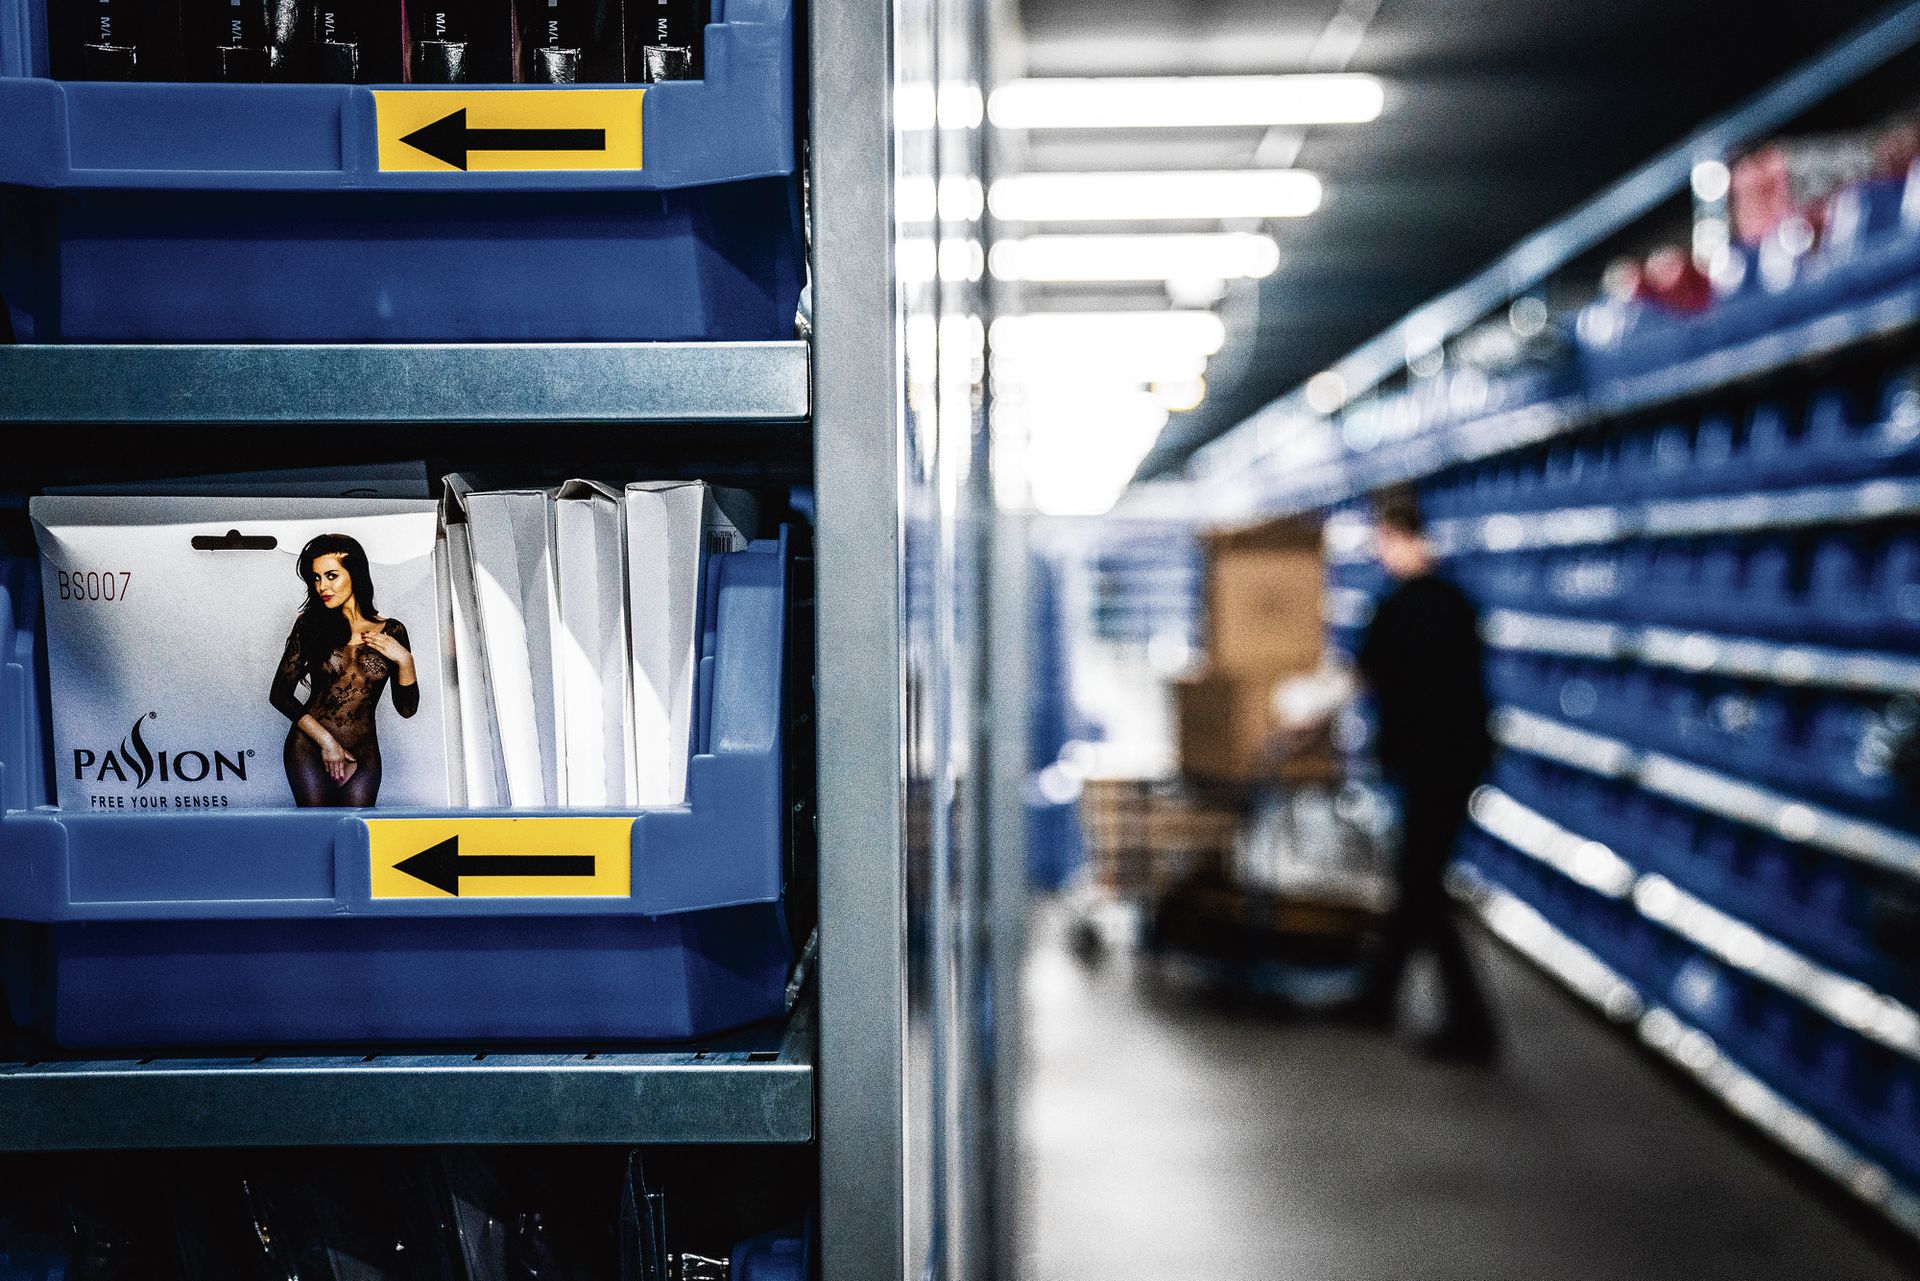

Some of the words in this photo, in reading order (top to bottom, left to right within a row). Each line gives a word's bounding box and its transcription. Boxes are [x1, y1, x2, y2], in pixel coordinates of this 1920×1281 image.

[324, 12, 335, 36] M/L
[436, 12, 447, 36] M/L
[548, 20, 559, 43] M/L
[657, 17, 668, 41] M/L
[58, 570, 132, 602] BS007
[91, 795, 125, 809] FREE
[131, 795, 168, 809] YOUR
[175, 795, 229, 808] SENSES
